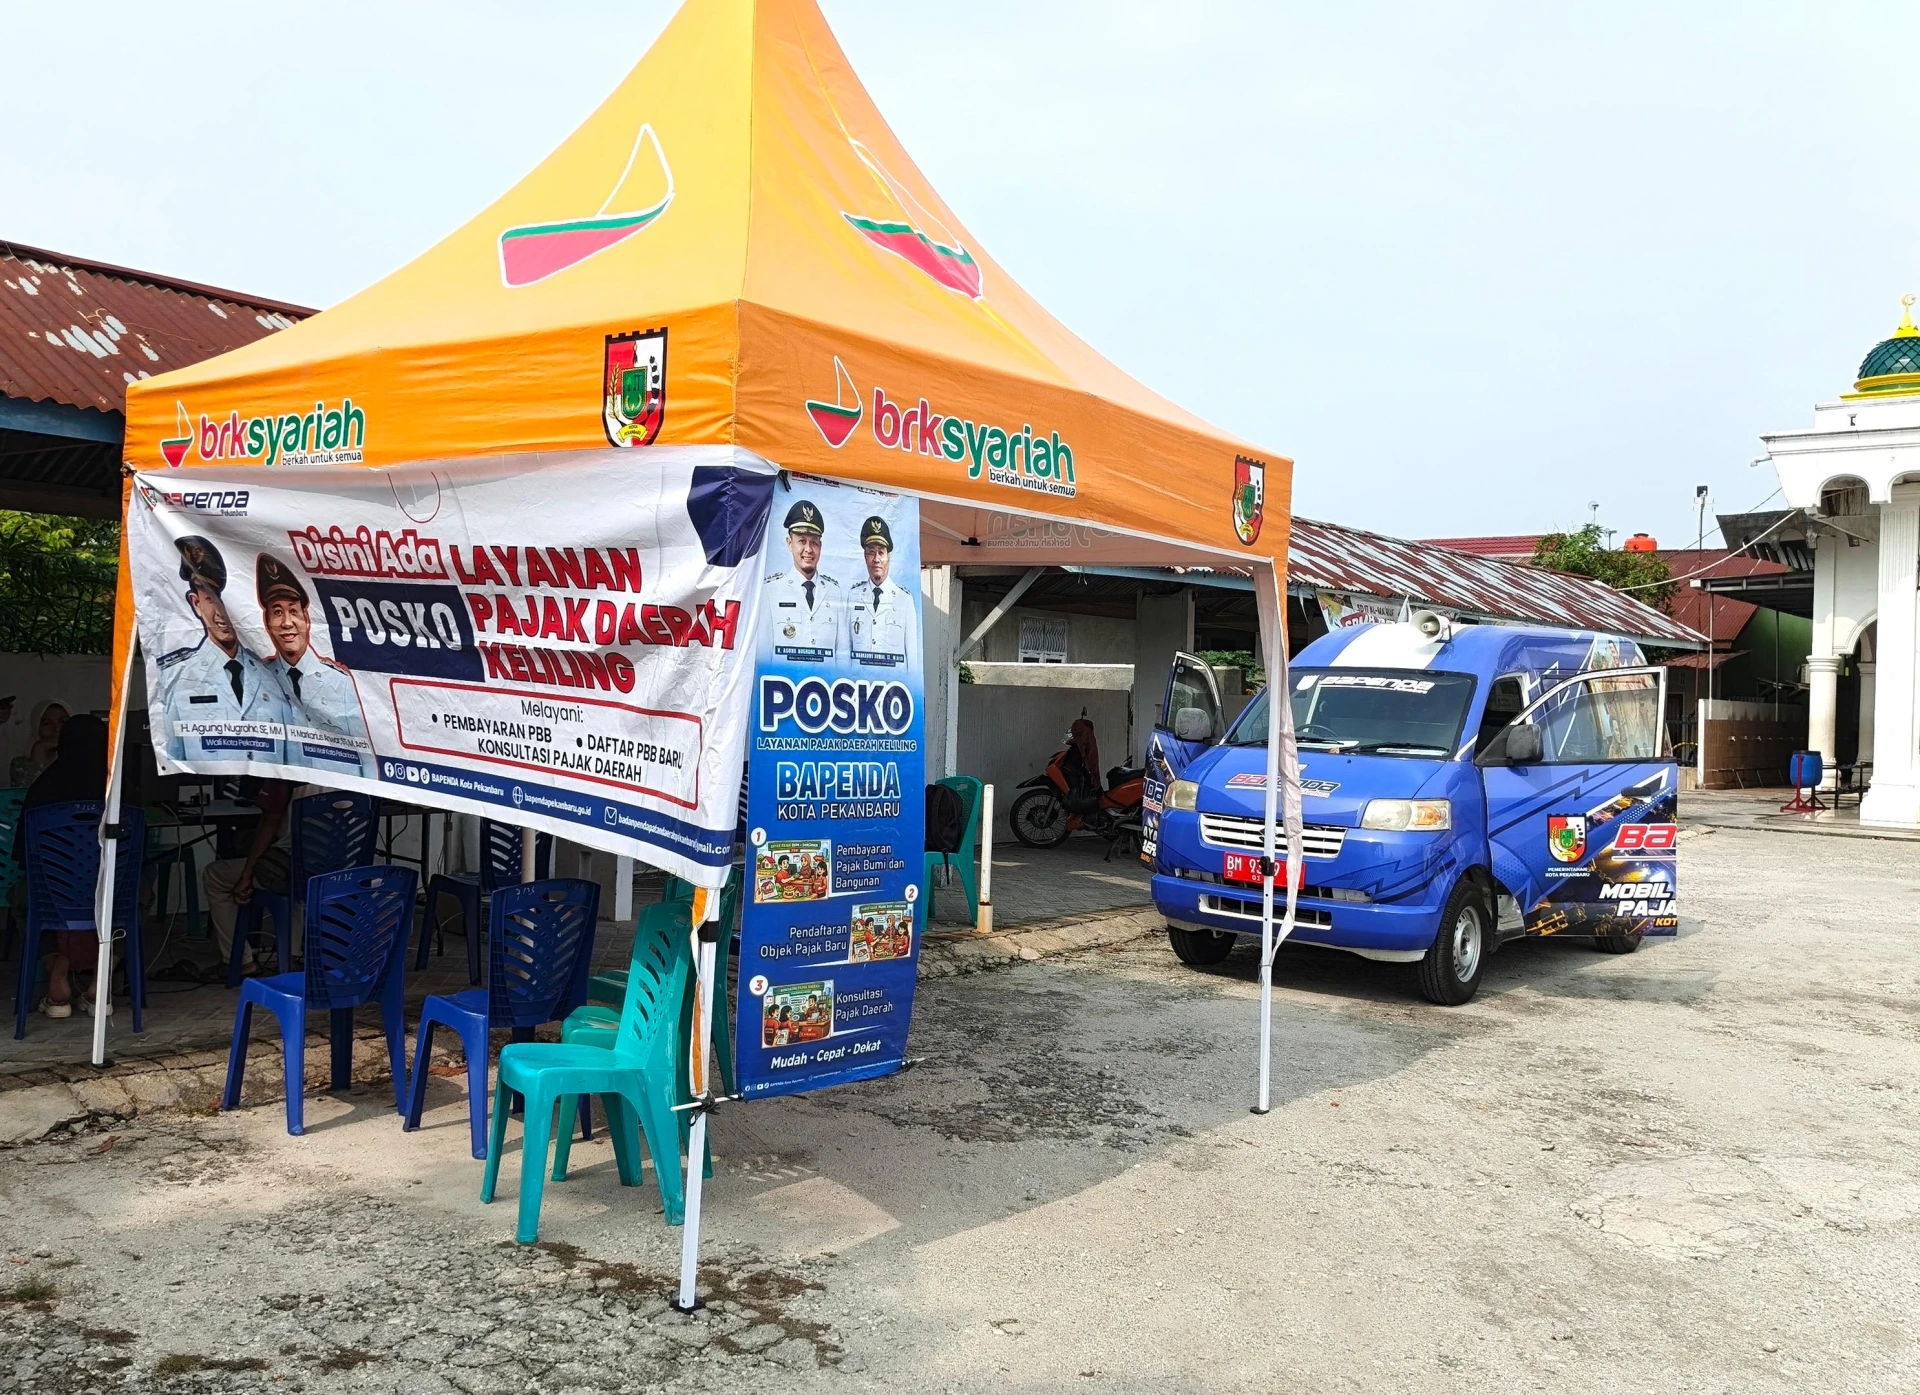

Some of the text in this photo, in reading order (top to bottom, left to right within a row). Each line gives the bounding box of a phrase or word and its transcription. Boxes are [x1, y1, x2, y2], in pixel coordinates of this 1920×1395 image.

[200, 398, 365, 466] brksyariah
[873, 386, 1076, 484] brksyariah
[283, 451, 362, 466] berkah untuk semua
[990, 469, 1075, 497] berkah untuk semua
[289, 526, 448, 578] Disini Ada
[449, 545, 642, 593] LAYANAN
[330, 596, 462, 651] POSKO
[466, 593, 741, 650] PAJAK DAERAH
[479, 641, 636, 694] KELILING
[521, 700, 584, 724] Melayani:
[761, 677, 912, 733] POSKO
[192, 723, 223, 735] Agung
[269, 725, 283, 736] MM
[443, 714, 552, 743] PEMBAYARAN PBB
[205, 738, 222, 747] Wali
[222, 738, 238, 747] Kota
[587, 734, 684, 769] DAFTAR PBB BARU
[757, 737, 916, 752] LAYANAN PAJAK DAERAH KELILING
[478, 738, 642, 782] KONSULTASI PAJAK DAERAH
[431, 773, 504, 796] BAPENDA Kota Pekanbaru
[777, 761, 902, 800] BAPENDA
[524, 793, 592, 815] bapendapekanbaru.go.id
[778, 802, 900, 819] KOTA PEKANBARU
[756, 831, 761, 842] 1
[837, 844, 892, 857] Pembayaran
[836, 860, 905, 874] Pajak Bumi dan
[1227, 856, 1280, 877] BM 939
[836, 876, 880, 890] Bangunan
[908, 888, 915, 899] 2
[1599, 883, 1671, 899] MOBIL
[790, 925, 847, 938] Pendaftaran
[760, 940, 847, 959] Objek Pajak Baru
[755, 979, 763, 992] 3
[836, 988, 883, 1004] Konsultasi
[836, 1003, 893, 1022] Pajak Daerah
[771, 1051, 807, 1069] Mudah
[816, 1046, 845, 1063] Cepat
[853, 1040, 881, 1055] Dekat
